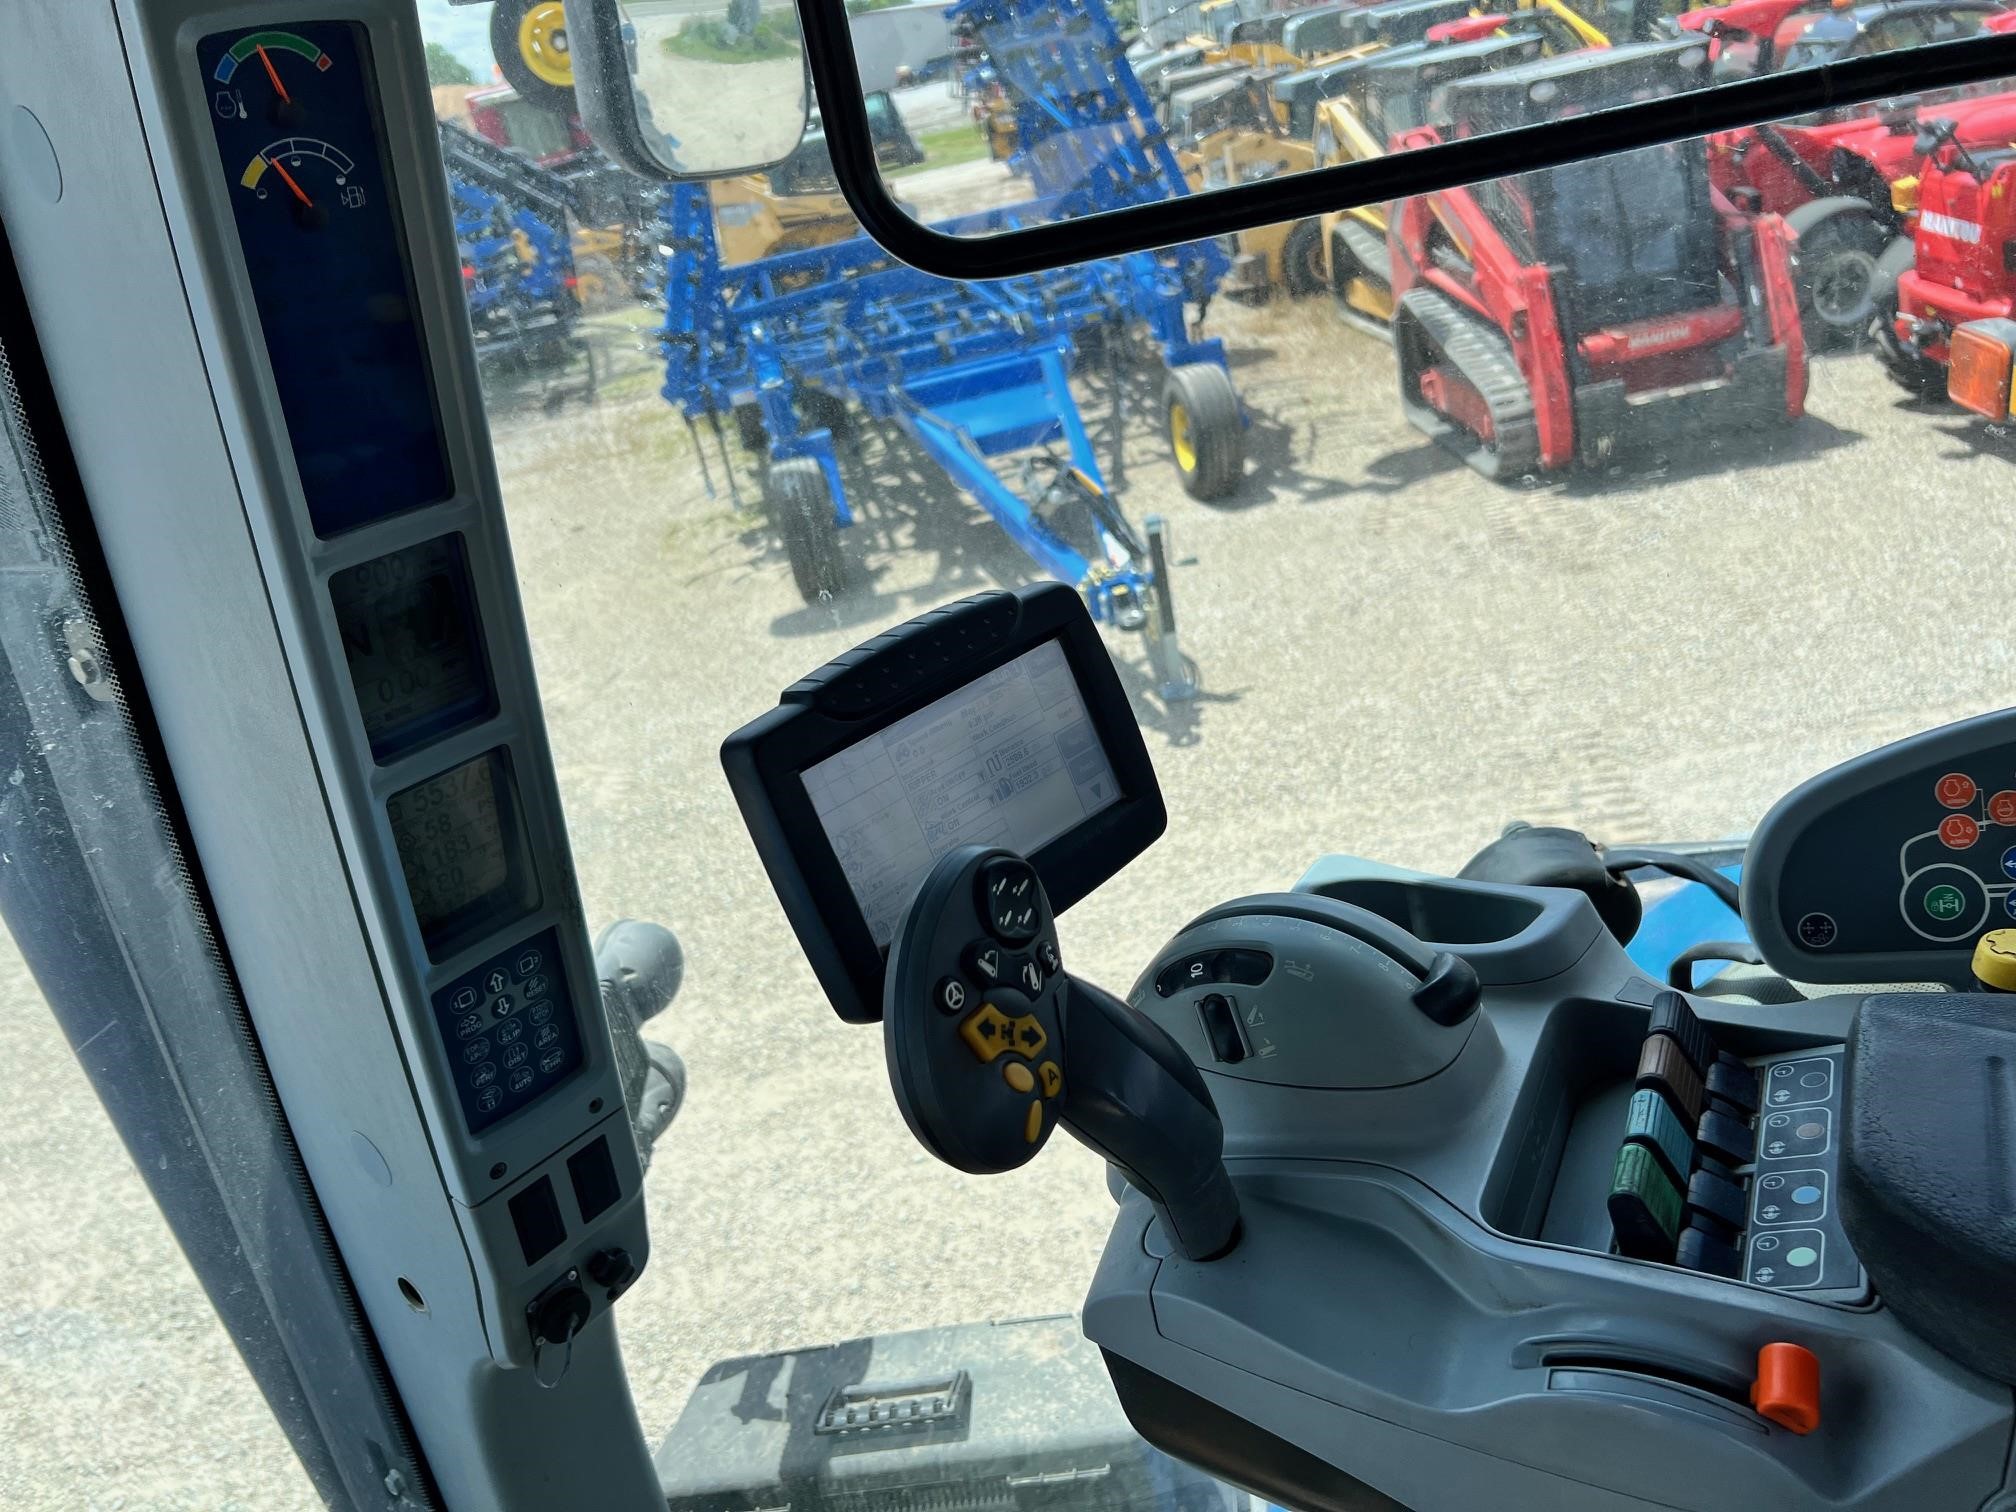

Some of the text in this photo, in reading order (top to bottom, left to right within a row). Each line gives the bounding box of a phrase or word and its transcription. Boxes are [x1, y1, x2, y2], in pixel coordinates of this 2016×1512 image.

[1628, 326, 1690, 349] MANITOU
[425, 813, 452, 841] 58
[1190, 962, 1204, 979] 10
[525, 982, 547, 999] RESET
[459, 1021, 483, 1037] PROG
[502, 1028, 521, 1043] SLIP
[538, 1032, 558, 1047] AREA
[507, 1052, 526, 1068] DIST
[514, 1076, 533, 1091] AUTO
